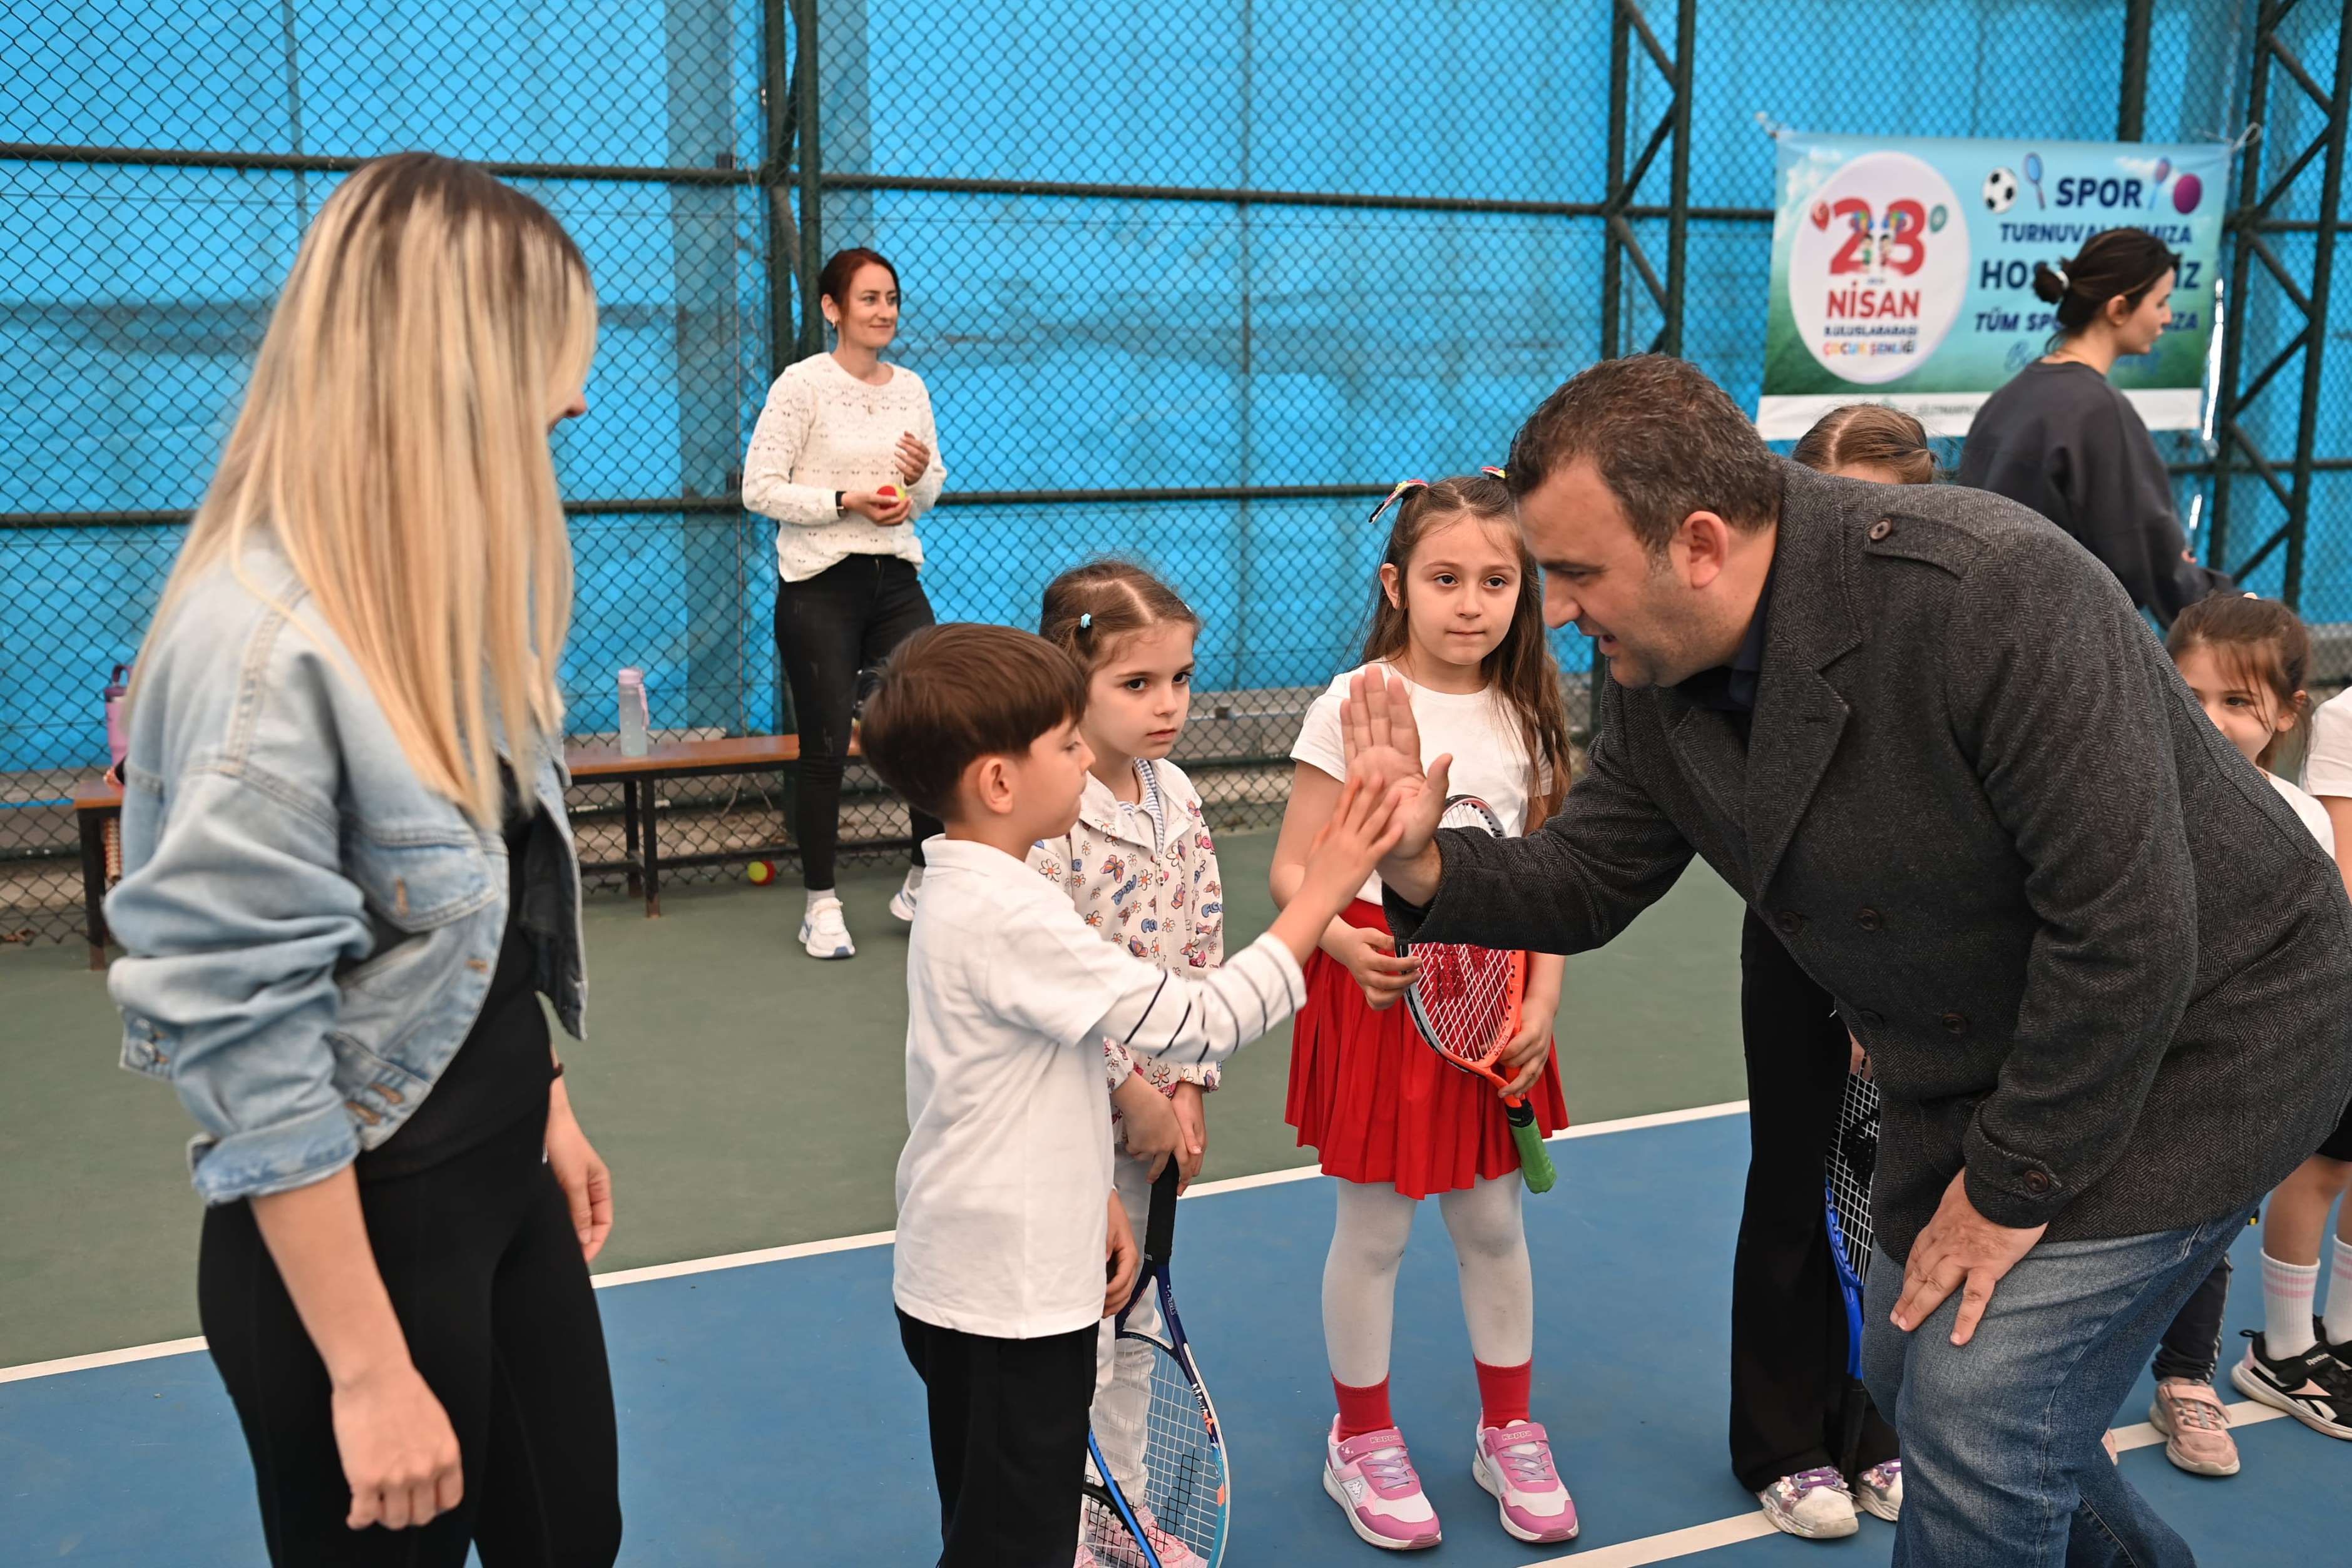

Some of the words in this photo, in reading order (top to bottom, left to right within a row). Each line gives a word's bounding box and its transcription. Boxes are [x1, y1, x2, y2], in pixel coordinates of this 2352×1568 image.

[2056, 178, 2143, 208] SPOR
[1829, 197, 1926, 276] 23
[1826, 280, 1921, 318] NİSAN
[1975, 307, 2019, 332] TÜM
[1369, 1435, 1399, 1443] Kappa
[1502, 1430, 1532, 1440] Kappa
